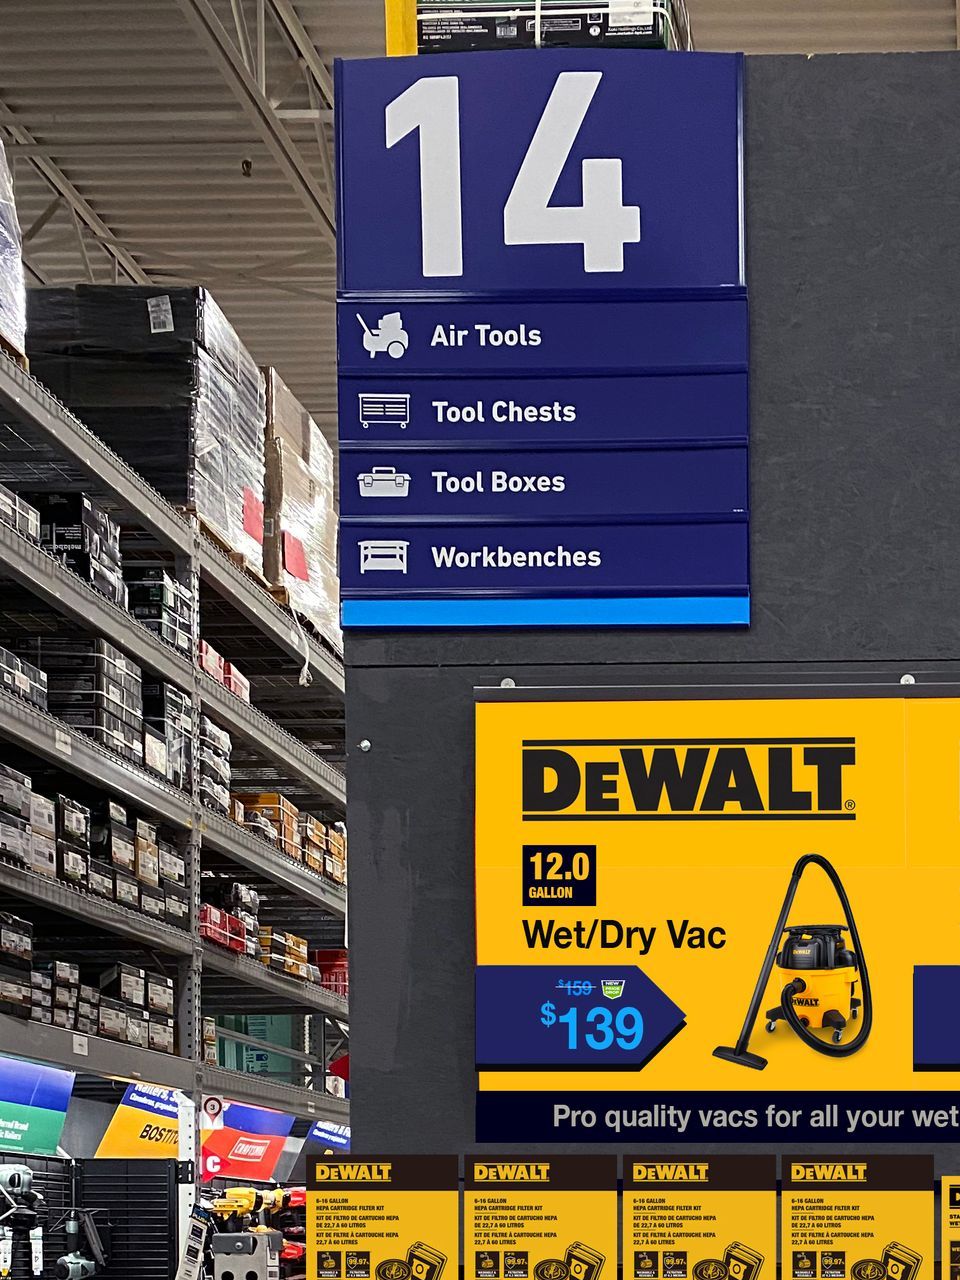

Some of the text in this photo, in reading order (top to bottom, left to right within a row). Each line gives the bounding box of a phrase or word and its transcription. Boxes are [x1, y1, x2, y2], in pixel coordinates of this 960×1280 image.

[386, 72, 640, 277] 14
[431, 324, 541, 346] Air Tools
[432, 401, 576, 422] Tool Chests
[432, 471, 565, 493] Tool Boxes
[431, 545, 602, 568] Workbenches
[529, 852, 590, 881] 12.0
[529, 886, 573, 899] GALLON
[522, 919, 727, 955] Wet/Dry Vac
[558, 979, 592, 996] $159
[540, 1000, 644, 1051] $139
[554, 1105, 596, 1128] Pro
[605, 1105, 691, 1133] quality
[699, 1110, 757, 1128] vacs
[766, 1105, 802, 1128] for
[810, 1105, 837, 1128] all
[846, 1110, 904, 1133] your
[912, 1106, 959, 1128] wet
[206, 1155, 221, 1173] C
